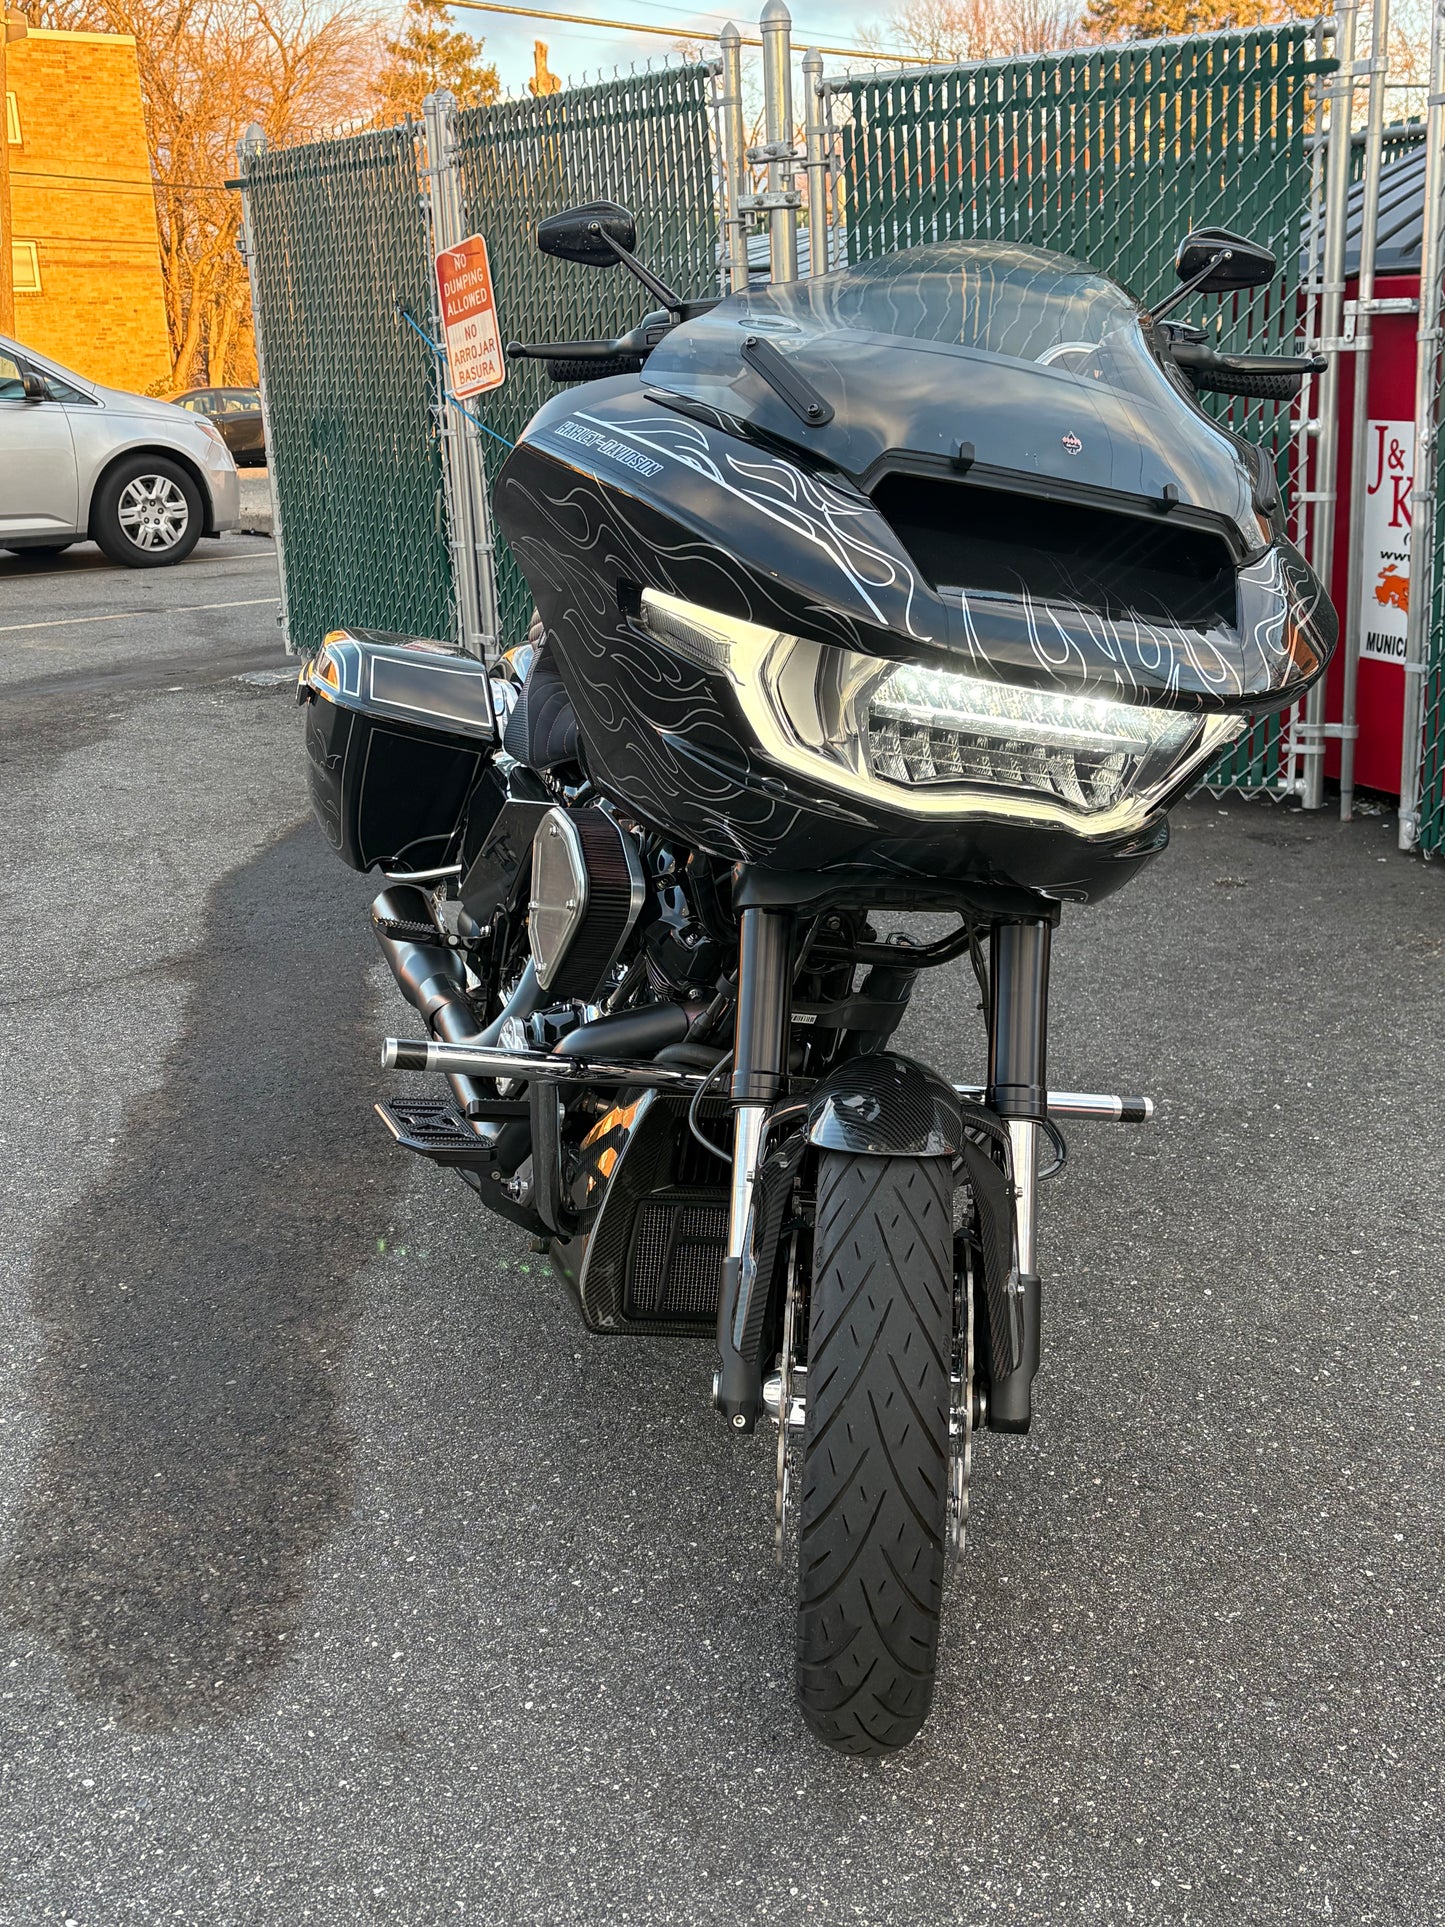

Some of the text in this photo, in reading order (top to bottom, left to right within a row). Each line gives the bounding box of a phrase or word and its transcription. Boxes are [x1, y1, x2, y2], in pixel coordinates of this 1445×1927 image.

[454, 254, 467, 272] NO
[444, 267, 484, 297] DUMPING
[447, 288, 488, 318] ALLOWED
[464, 324, 477, 341] NO
[454, 338, 496, 367] ARROJAR
[459, 362, 495, 385] BASURA
[554, 421, 664, 478] HARLEY-DAVIDSON
